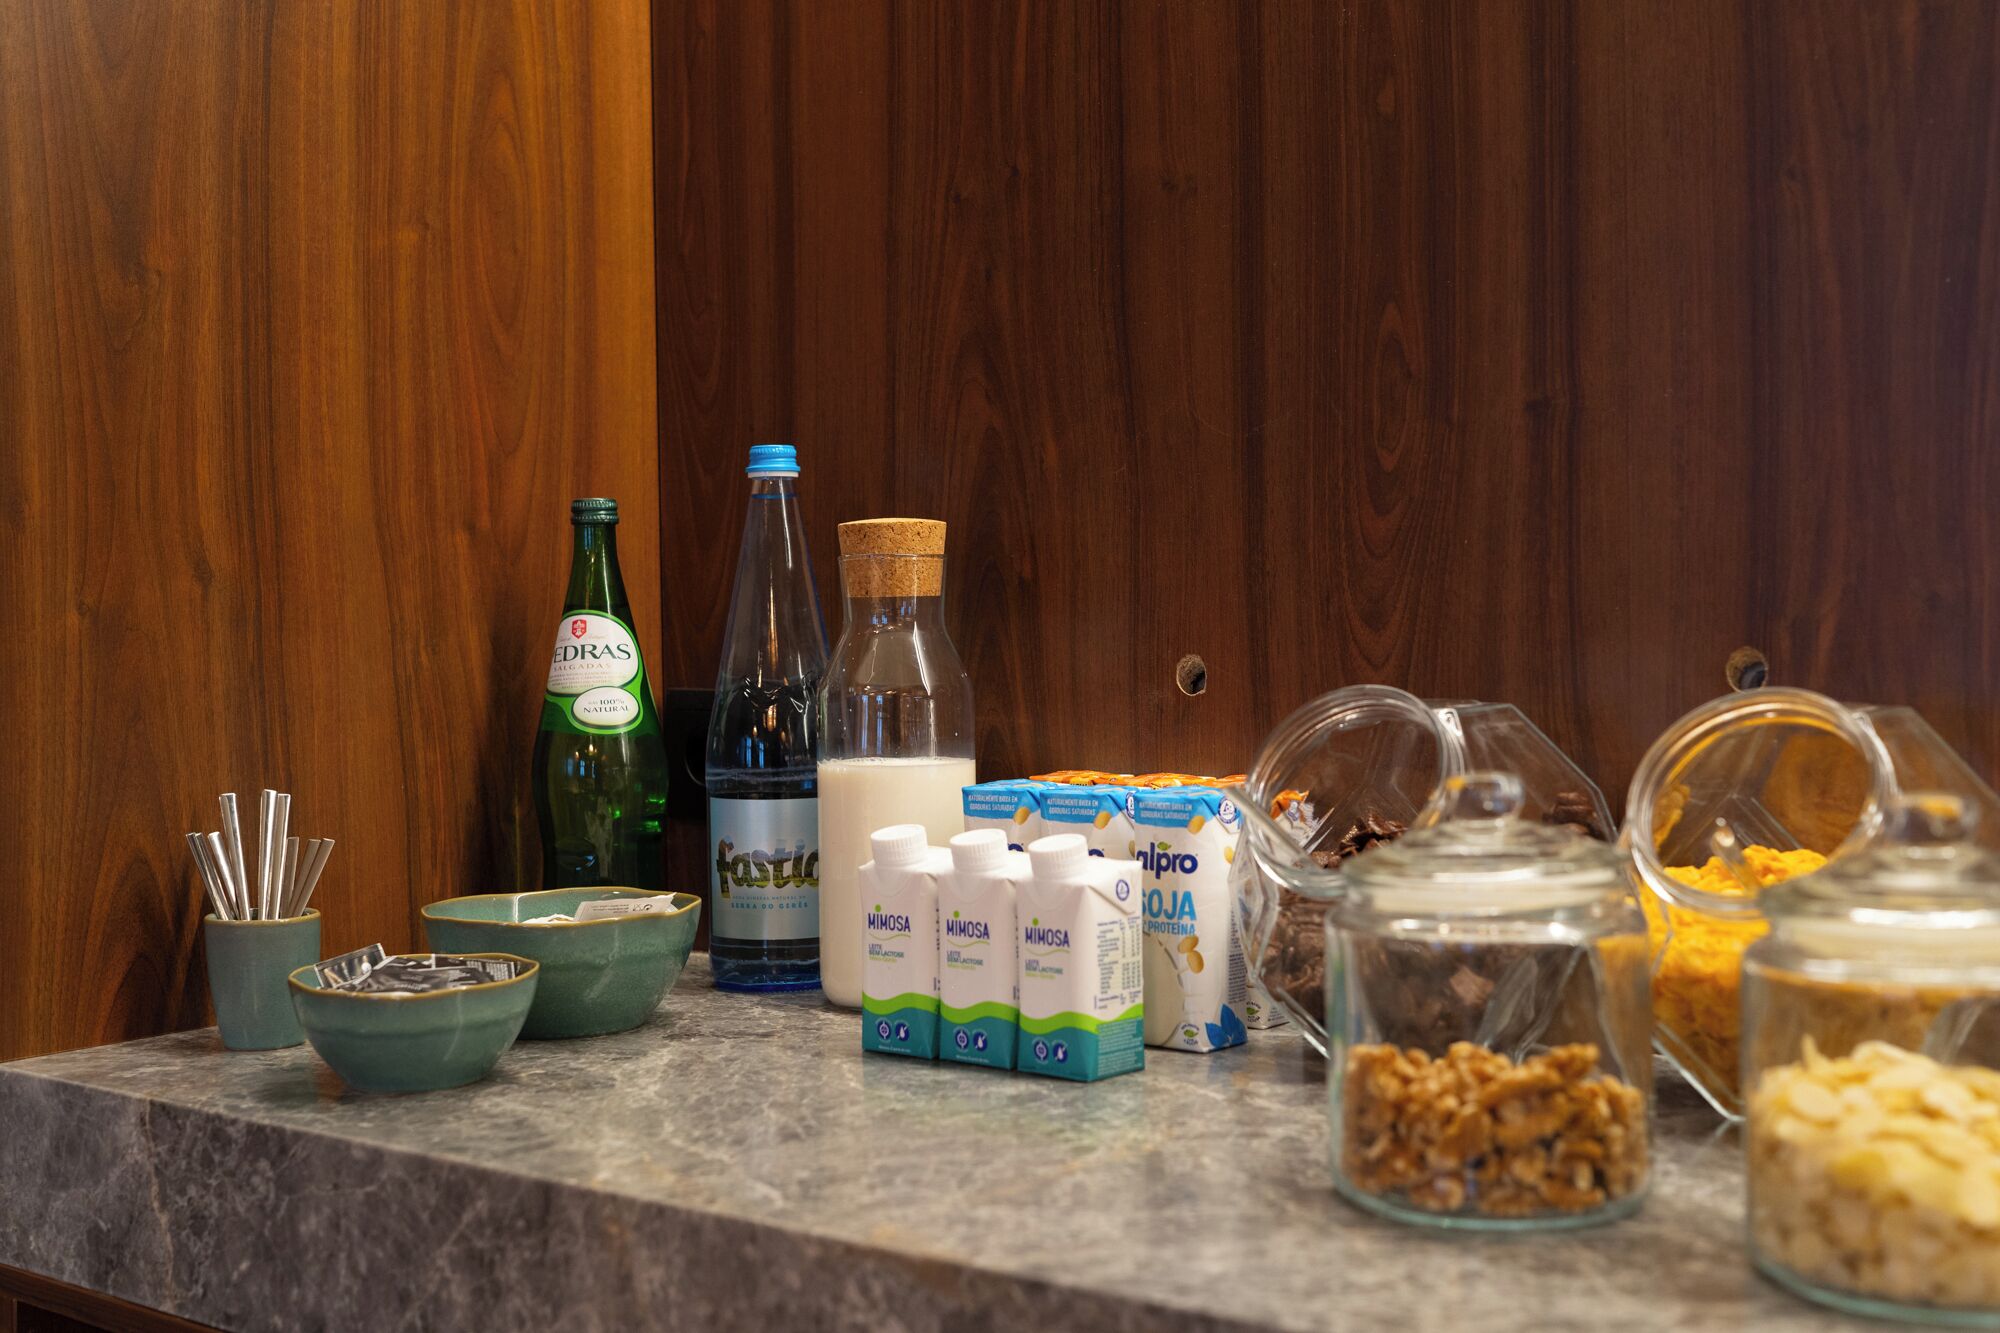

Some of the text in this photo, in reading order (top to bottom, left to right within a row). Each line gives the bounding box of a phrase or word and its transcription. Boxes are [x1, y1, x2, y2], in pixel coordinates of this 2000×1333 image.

[554, 644, 631, 663] EDRAS
[583, 704, 630, 714] NATURAL
[868, 912, 911, 933] MIMOSA
[946, 919, 990, 940] MIMOSA
[1025, 927, 1070, 948] MIMOSA
